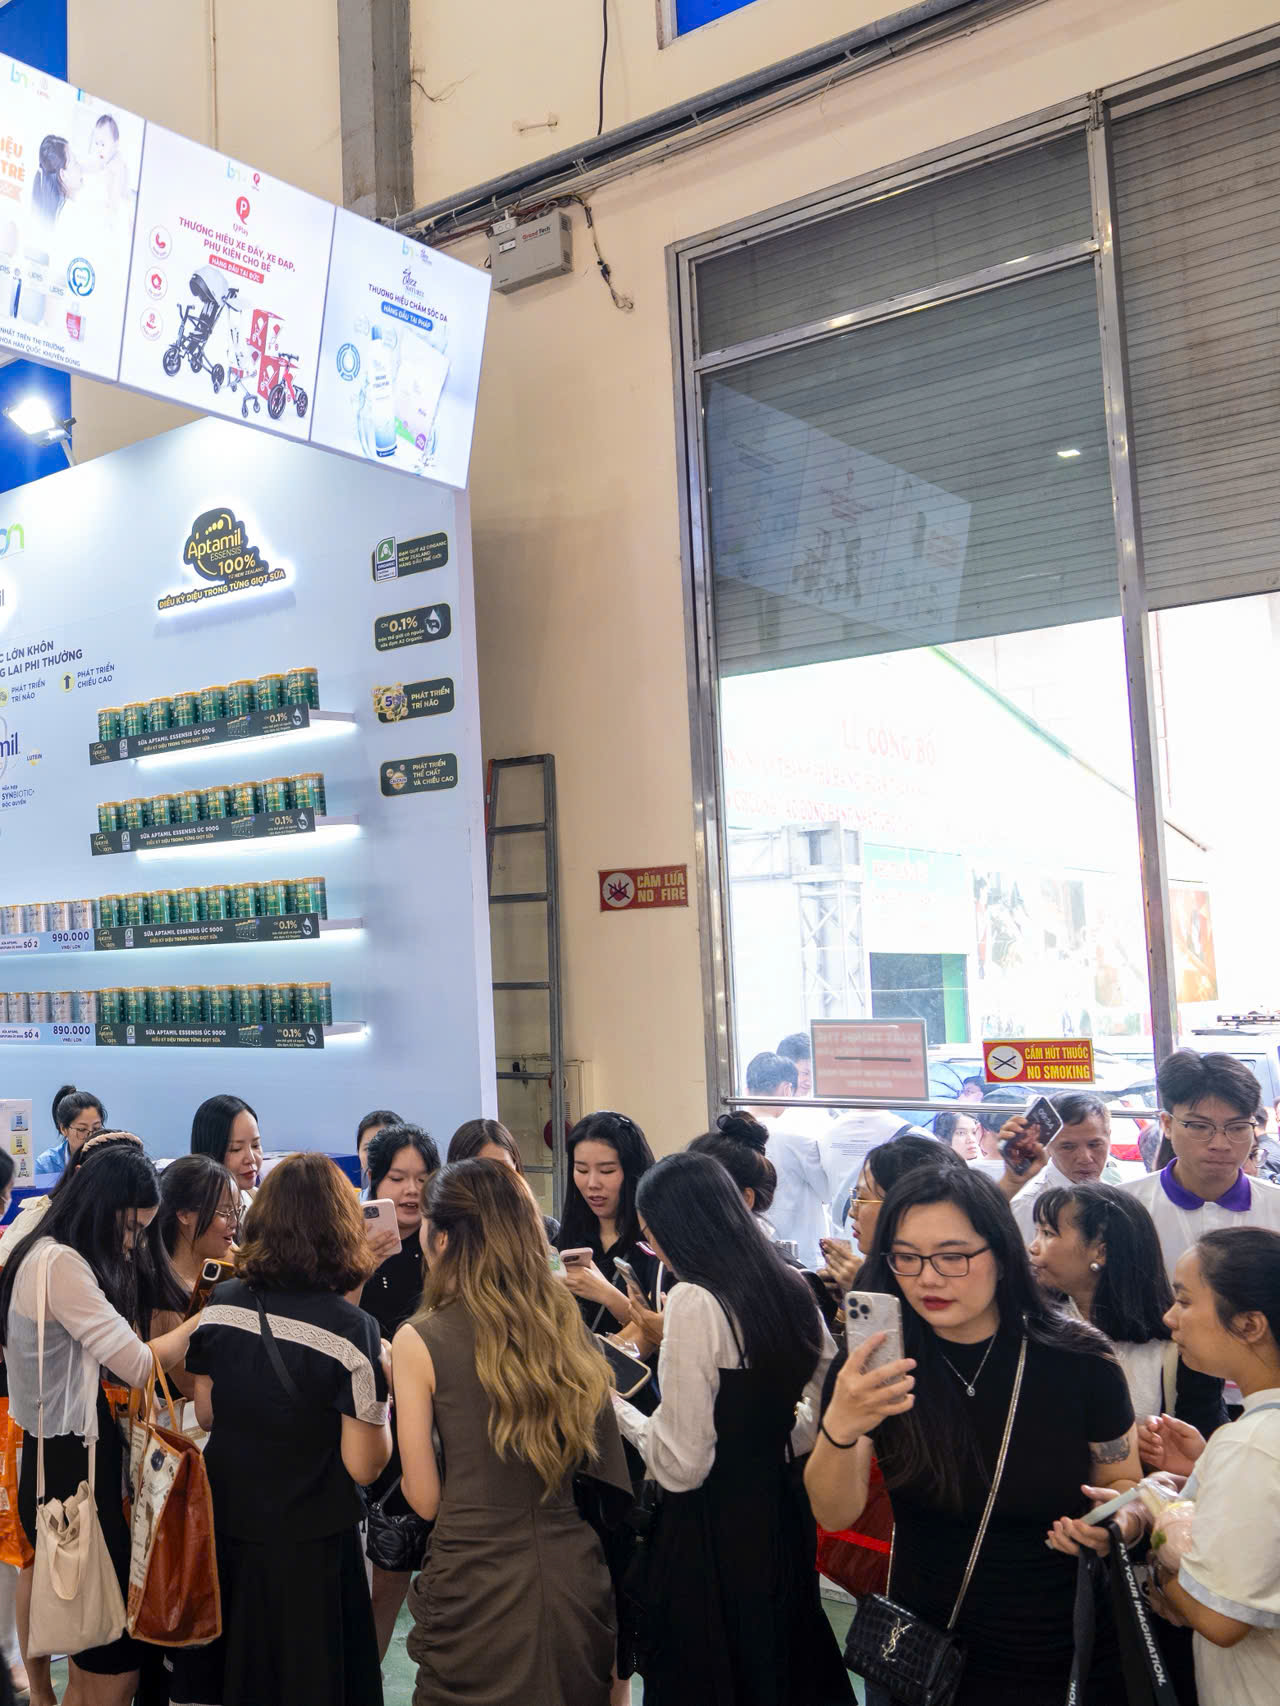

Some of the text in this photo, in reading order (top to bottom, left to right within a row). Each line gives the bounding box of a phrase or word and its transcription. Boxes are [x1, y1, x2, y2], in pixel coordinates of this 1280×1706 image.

[0, 160, 25, 183] TRẺ
[179, 216, 215, 238] THƯƠNG
[215, 230, 235, 247] HIỆU
[236, 240, 246, 251] XE
[267, 252, 277, 263] XE
[277, 257, 296, 273] ĐẠP,
[203, 238, 272, 273] PHỤ KIỆN CHO BÉ
[187, 527, 243, 560] Aptamil
[210, 545, 242, 562] ESSENSIS
[217, 552, 256, 576] 100%
[158, 595, 175, 609] ĐIỀU
[186, 588, 203, 603] DIỆU
[204, 584, 228, 598] TRONG
[229, 578, 250, 592] TỪNG
[250, 575, 268, 587] GIỌT
[269, 567, 285, 580] SỮA
[388, 616, 418, 633] 0.1%
[6, 647, 25, 664] LỚN
[27, 640, 55, 658] KHÔN
[7, 663, 23, 677] LAI
[24, 659, 40, 673] PHI
[42, 649, 83, 668] THƯỜNG
[77, 661, 116, 679] PHÁT TRIỂN
[77, 674, 113, 689] CHIỀU CAO
[411, 690, 430, 700] PHÁT
[430, 685, 450, 697] TRIỂN
[411, 699, 439, 710] TRÍ NÃO
[148, 736, 169, 746] APTAMIL
[169, 731, 193, 741] ESSENSIS
[201, 727, 216, 735] 900G
[269, 713, 288, 723] 0.1%
[637, 887, 686, 903] NO FIRE
[52, 931, 90, 943] 990.000
[53, 1025, 91, 1035] 890.000
[1024, 1042, 1089, 1060] CẤM HÚT THUỐC
[1026, 1065, 1090, 1080] NO SMOKING
[1124, 1565, 1140, 1599] YOUR
[1133, 1600, 1169, 1688] IMAGINATION.
